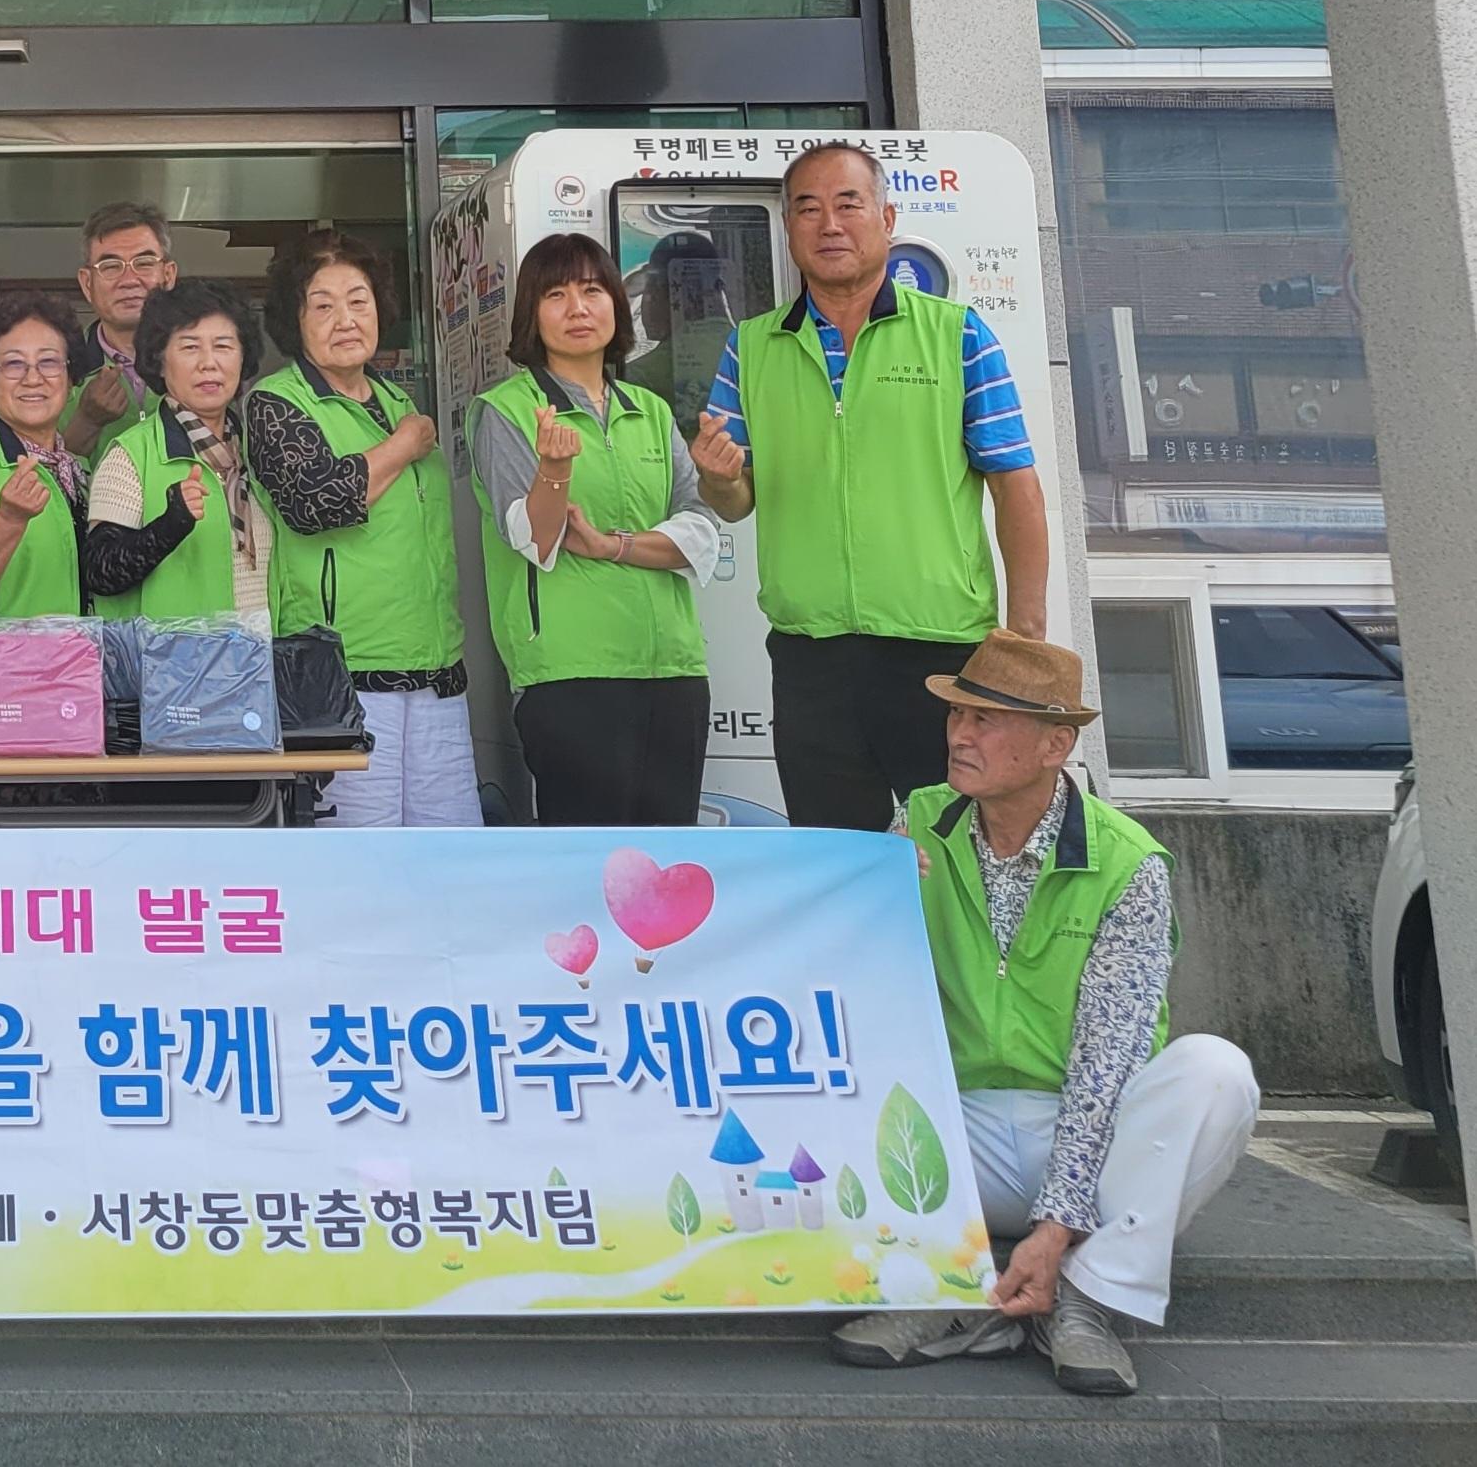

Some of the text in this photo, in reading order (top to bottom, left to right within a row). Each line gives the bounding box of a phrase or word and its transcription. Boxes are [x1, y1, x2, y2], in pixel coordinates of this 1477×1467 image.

[633, 138, 929, 162] 투명페트병 무수로봇
[548, 209, 569, 218] CCTV
[908, 201, 959, 214] 프로젝트
[971, 295, 1019, 311] 적립가능
[709, 710, 773, 740] 리도
[138, 887, 285, 954] 발굴
[79, 1004, 275, 1118] 함께
[309, 990, 851, 1120] 찾아주세요!
[82, 1189, 597, 1251] 서창동맞춤형복지팀
